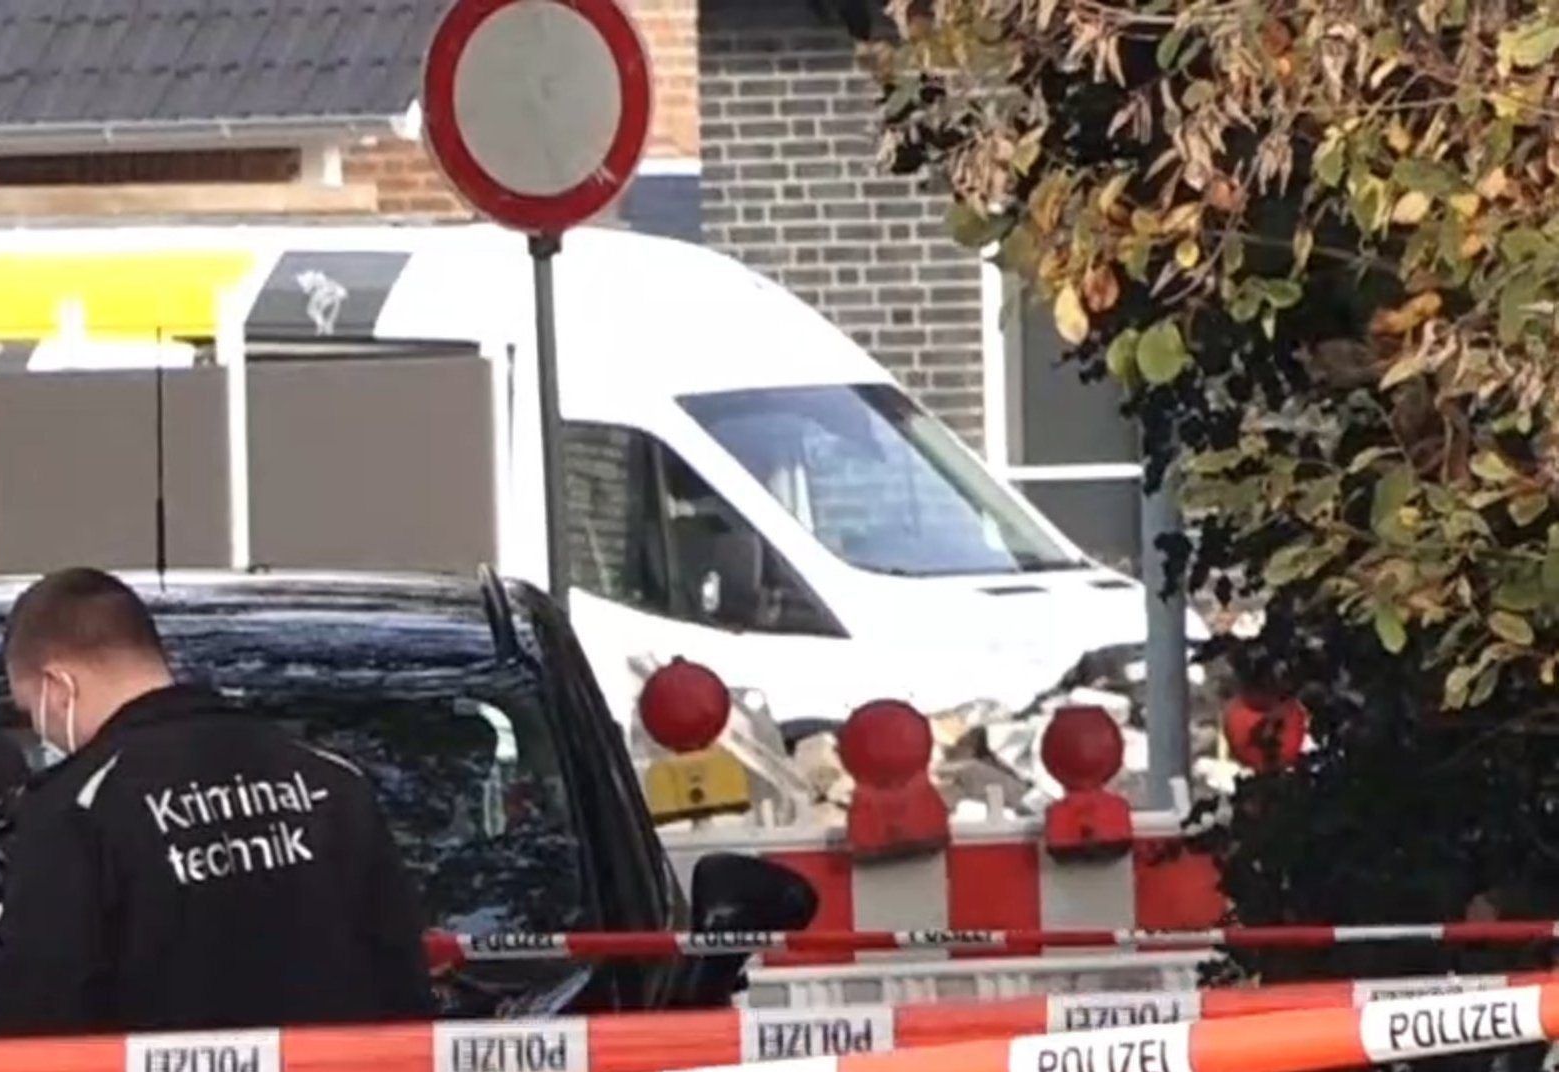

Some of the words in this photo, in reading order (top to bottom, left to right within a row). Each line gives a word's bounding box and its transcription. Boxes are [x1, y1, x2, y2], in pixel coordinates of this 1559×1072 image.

[145, 770, 329, 834] Kriminal-
[167, 820, 314, 884] technik
[758, 1019, 873, 1061] POLIZEI
[1389, 1002, 1524, 1051] POLIZEI
